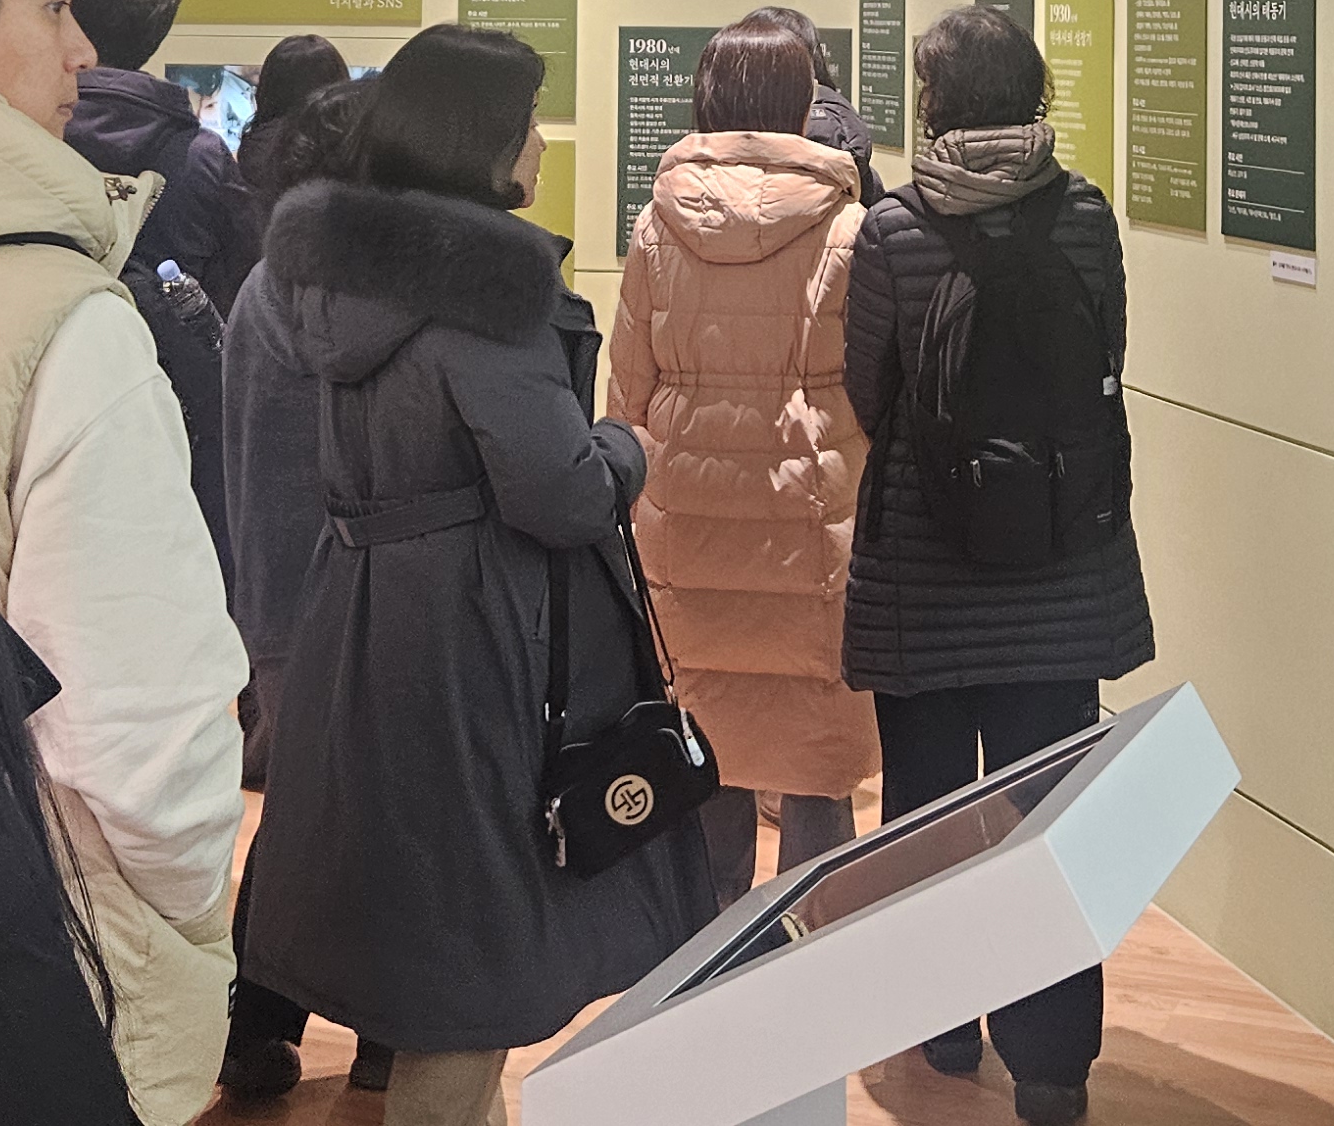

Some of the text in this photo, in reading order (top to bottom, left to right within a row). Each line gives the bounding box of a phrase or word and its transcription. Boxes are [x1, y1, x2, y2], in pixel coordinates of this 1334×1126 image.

[1229, 0, 1287, 20] 현대시의 태동기
[629, 38, 680, 54] 1980년대
[629, 58, 670, 71] 현대시의
[629, 74, 693, 86] 전면적 전환기
